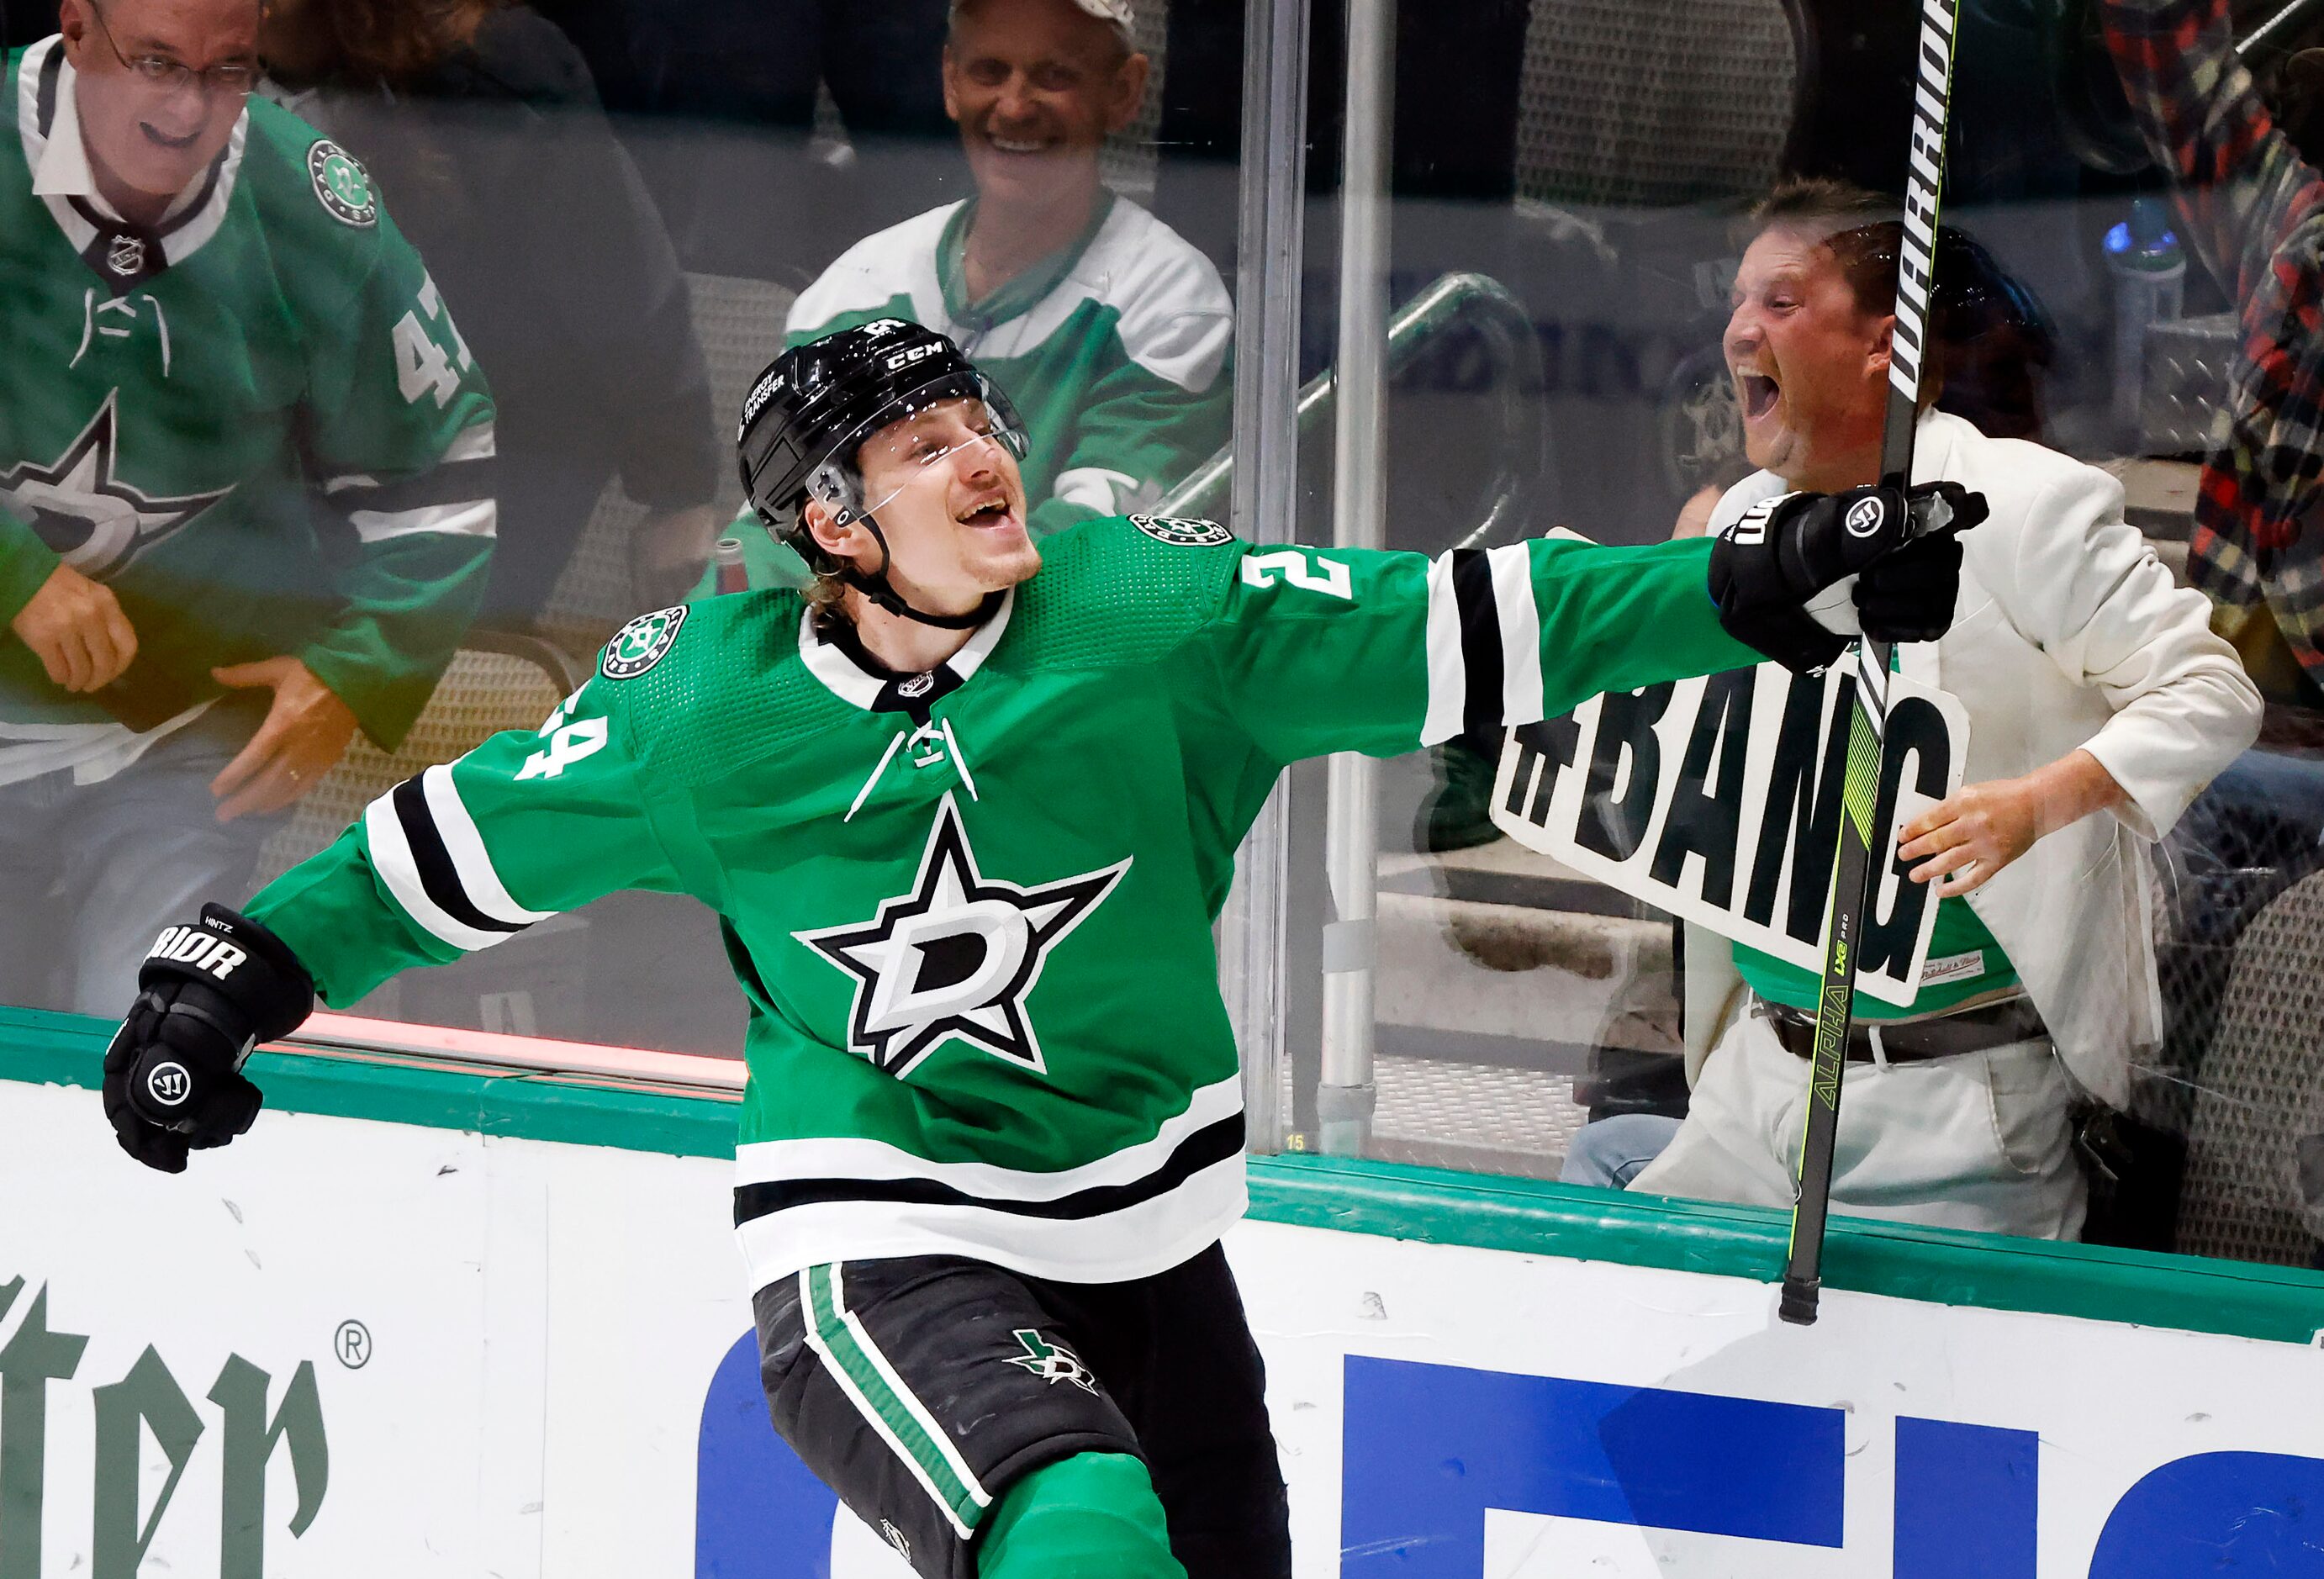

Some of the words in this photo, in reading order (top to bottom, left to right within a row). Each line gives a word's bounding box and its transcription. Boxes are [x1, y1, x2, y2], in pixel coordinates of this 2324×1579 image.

[887, 340, 943, 370] CCM
[744, 371, 775, 414] ENERGY
[745, 374, 784, 424] TRANSFER
[1241, 545, 1354, 600] 2
[1506, 667, 1950, 982] #BANG
[204, 915, 233, 934] HINTZ
[143, 926, 247, 980] RIOR
[1814, 985, 1849, 1110] ALPHA
[1841, 913, 1849, 939] PRO
[1287, 1134, 1304, 1151] 15
[0, 1276, 329, 1579] ter
